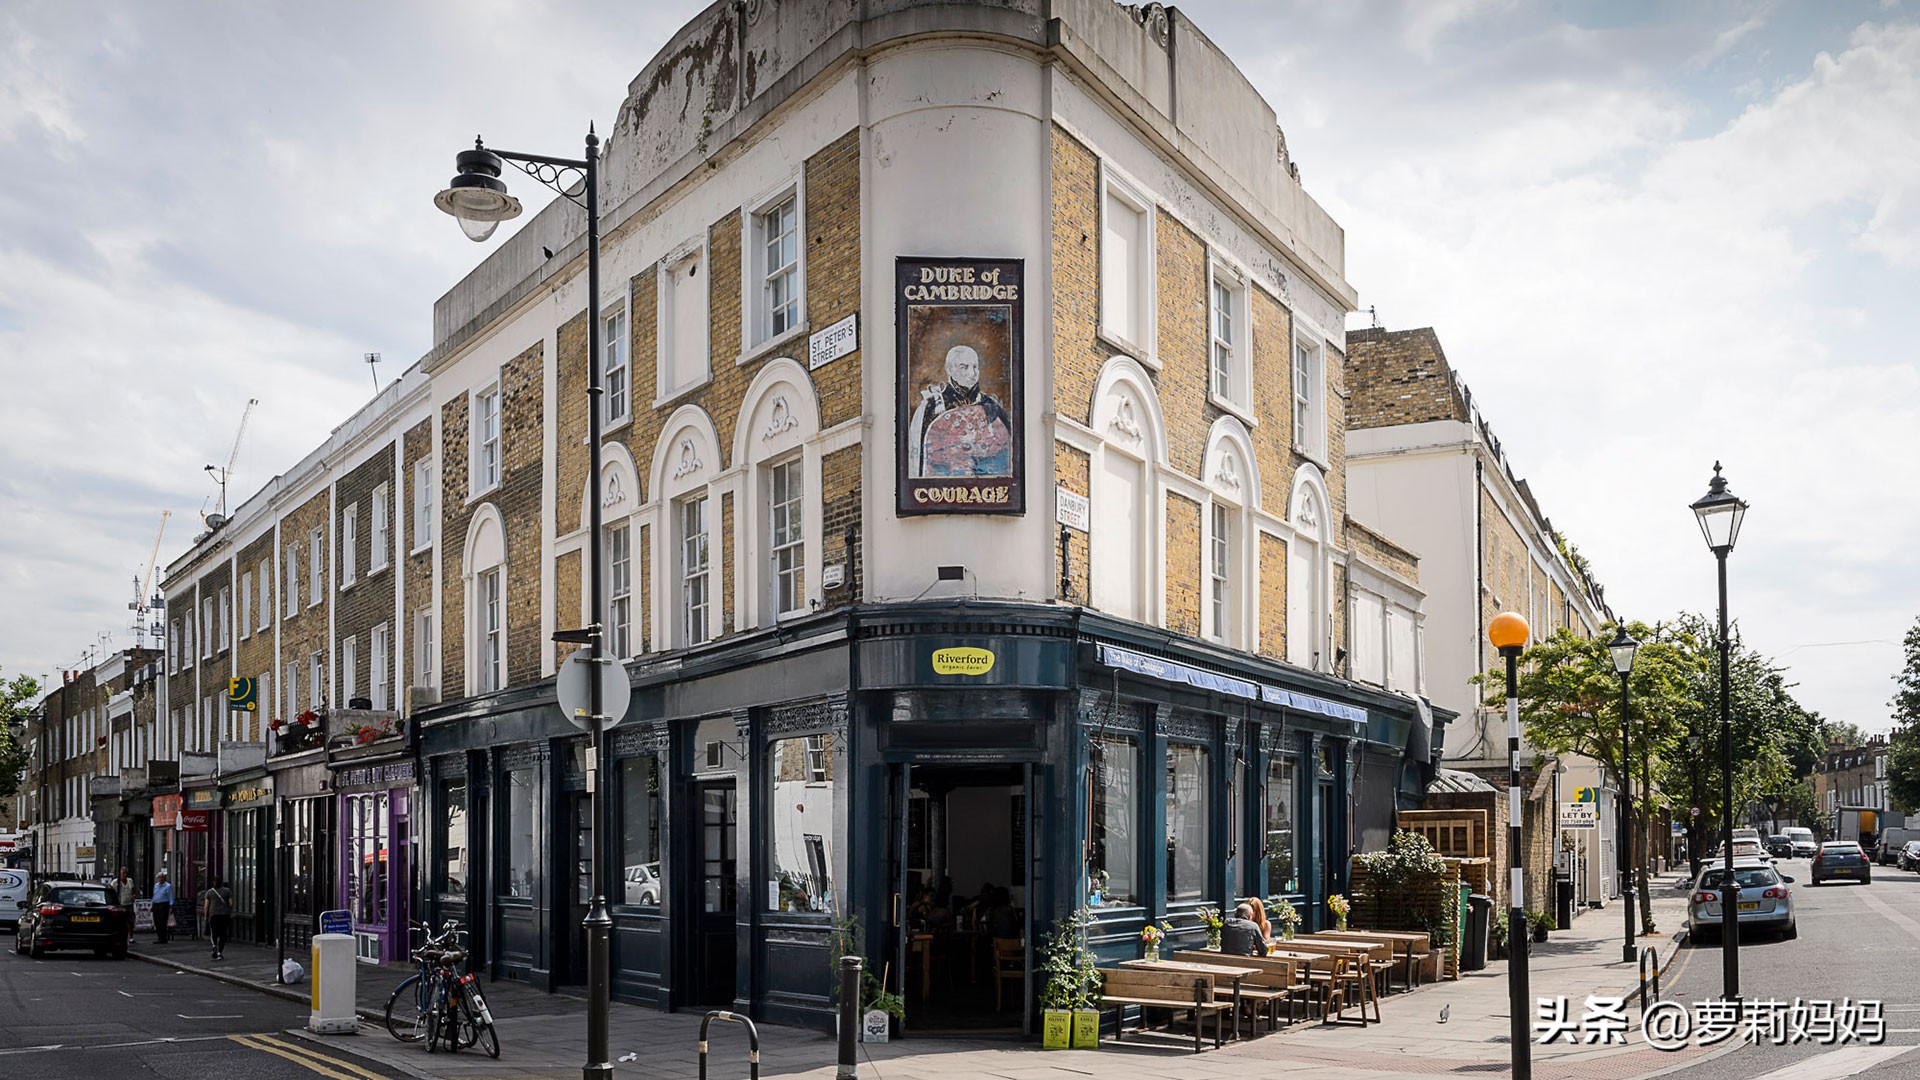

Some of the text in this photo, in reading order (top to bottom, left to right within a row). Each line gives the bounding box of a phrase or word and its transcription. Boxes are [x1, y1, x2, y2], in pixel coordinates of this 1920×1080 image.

[920, 267, 1001, 285] DUKE of
[904, 284, 1019, 301] CAMBRIDGE
[825, 324, 854, 347] PETER'S
[812, 344, 837, 366] STREET
[913, 486, 1009, 503] COURAGE
[1060, 495, 1087, 516] DANBURY
[1060, 508, 1081, 526] STREET
[937, 653, 988, 664] Riverford
